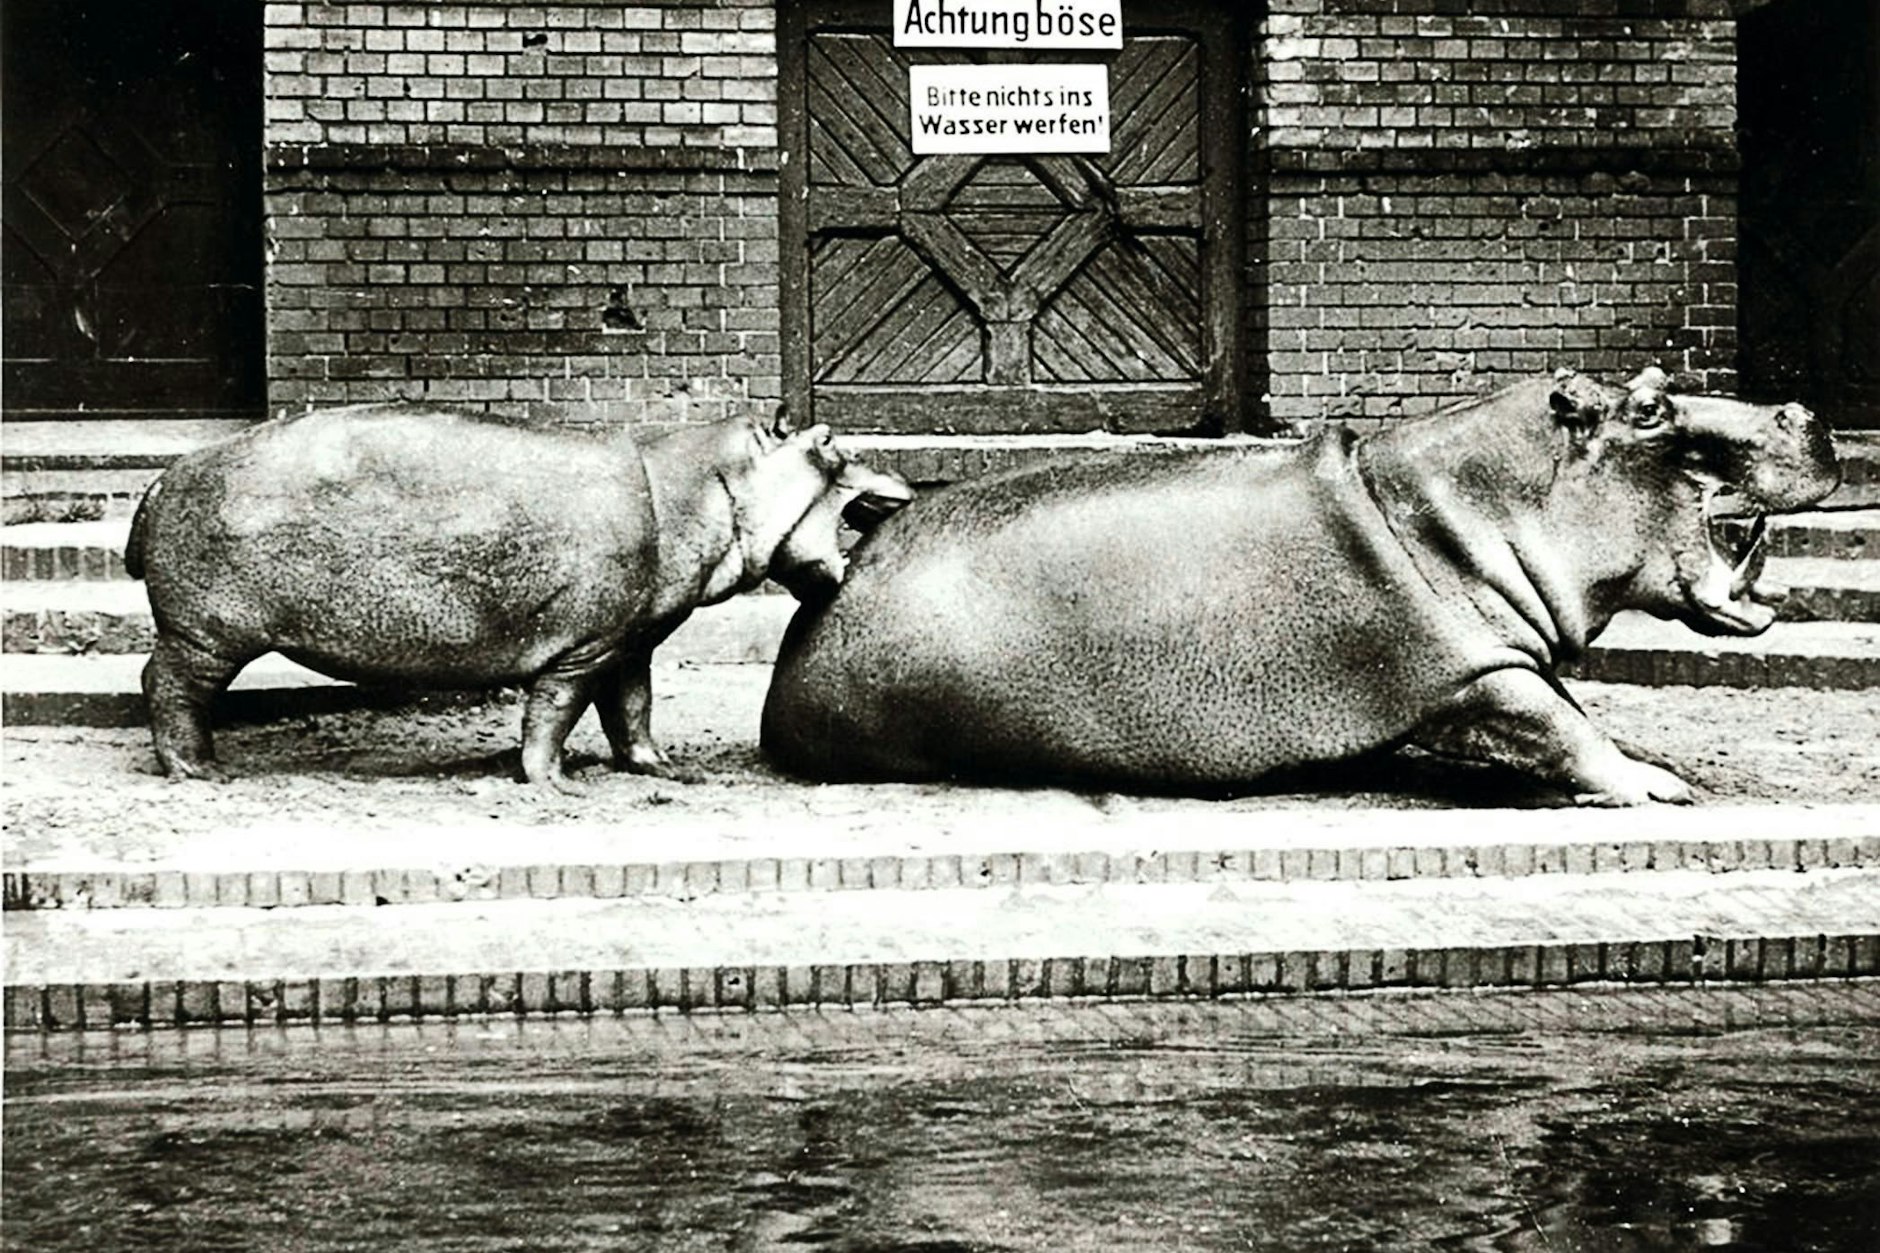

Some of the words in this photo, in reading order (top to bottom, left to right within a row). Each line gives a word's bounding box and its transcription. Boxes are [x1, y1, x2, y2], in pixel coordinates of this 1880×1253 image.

[904, 0, 1029, 42] Achtung
[1037, 0, 1116, 37] böse
[927, 86, 981, 107] Bitte
[987, 86, 1053, 107] nichts
[1060, 86, 1093, 107] ins
[919, 114, 1007, 135] Wasser
